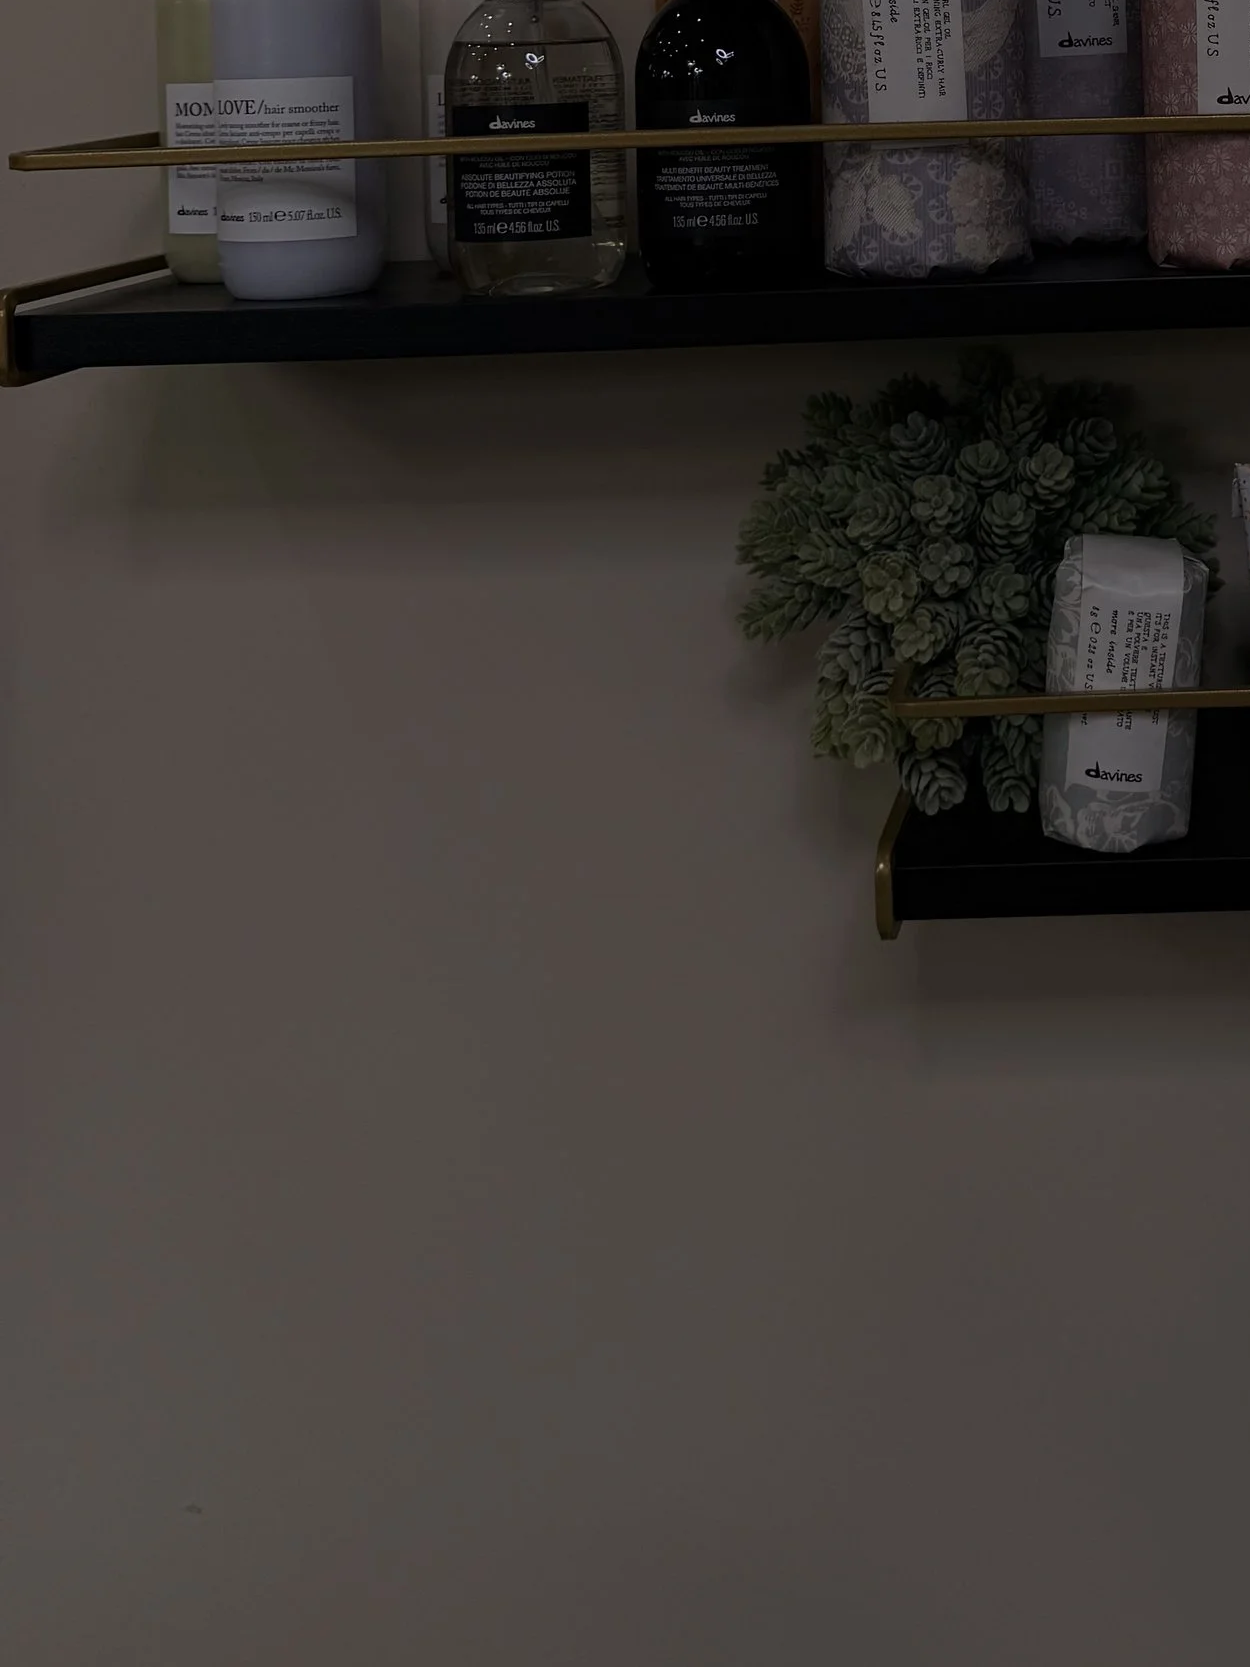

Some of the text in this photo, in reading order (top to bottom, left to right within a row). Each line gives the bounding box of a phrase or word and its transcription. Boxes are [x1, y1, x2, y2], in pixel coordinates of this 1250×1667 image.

[1058, 32, 1113, 48] davines
[288, 102, 339, 114] smoother
[489, 115, 536, 129] davines
[689, 108, 736, 123] davines
[494, 172, 544, 180] BEAUTIFYING
[497, 180, 534, 188] BELLEZZA
[536, 179, 577, 187] ASSOLUTA
[178, 205, 208, 216] davines
[1106, 610, 1118, 673] more inside
[1085, 760, 1142, 782] davines
